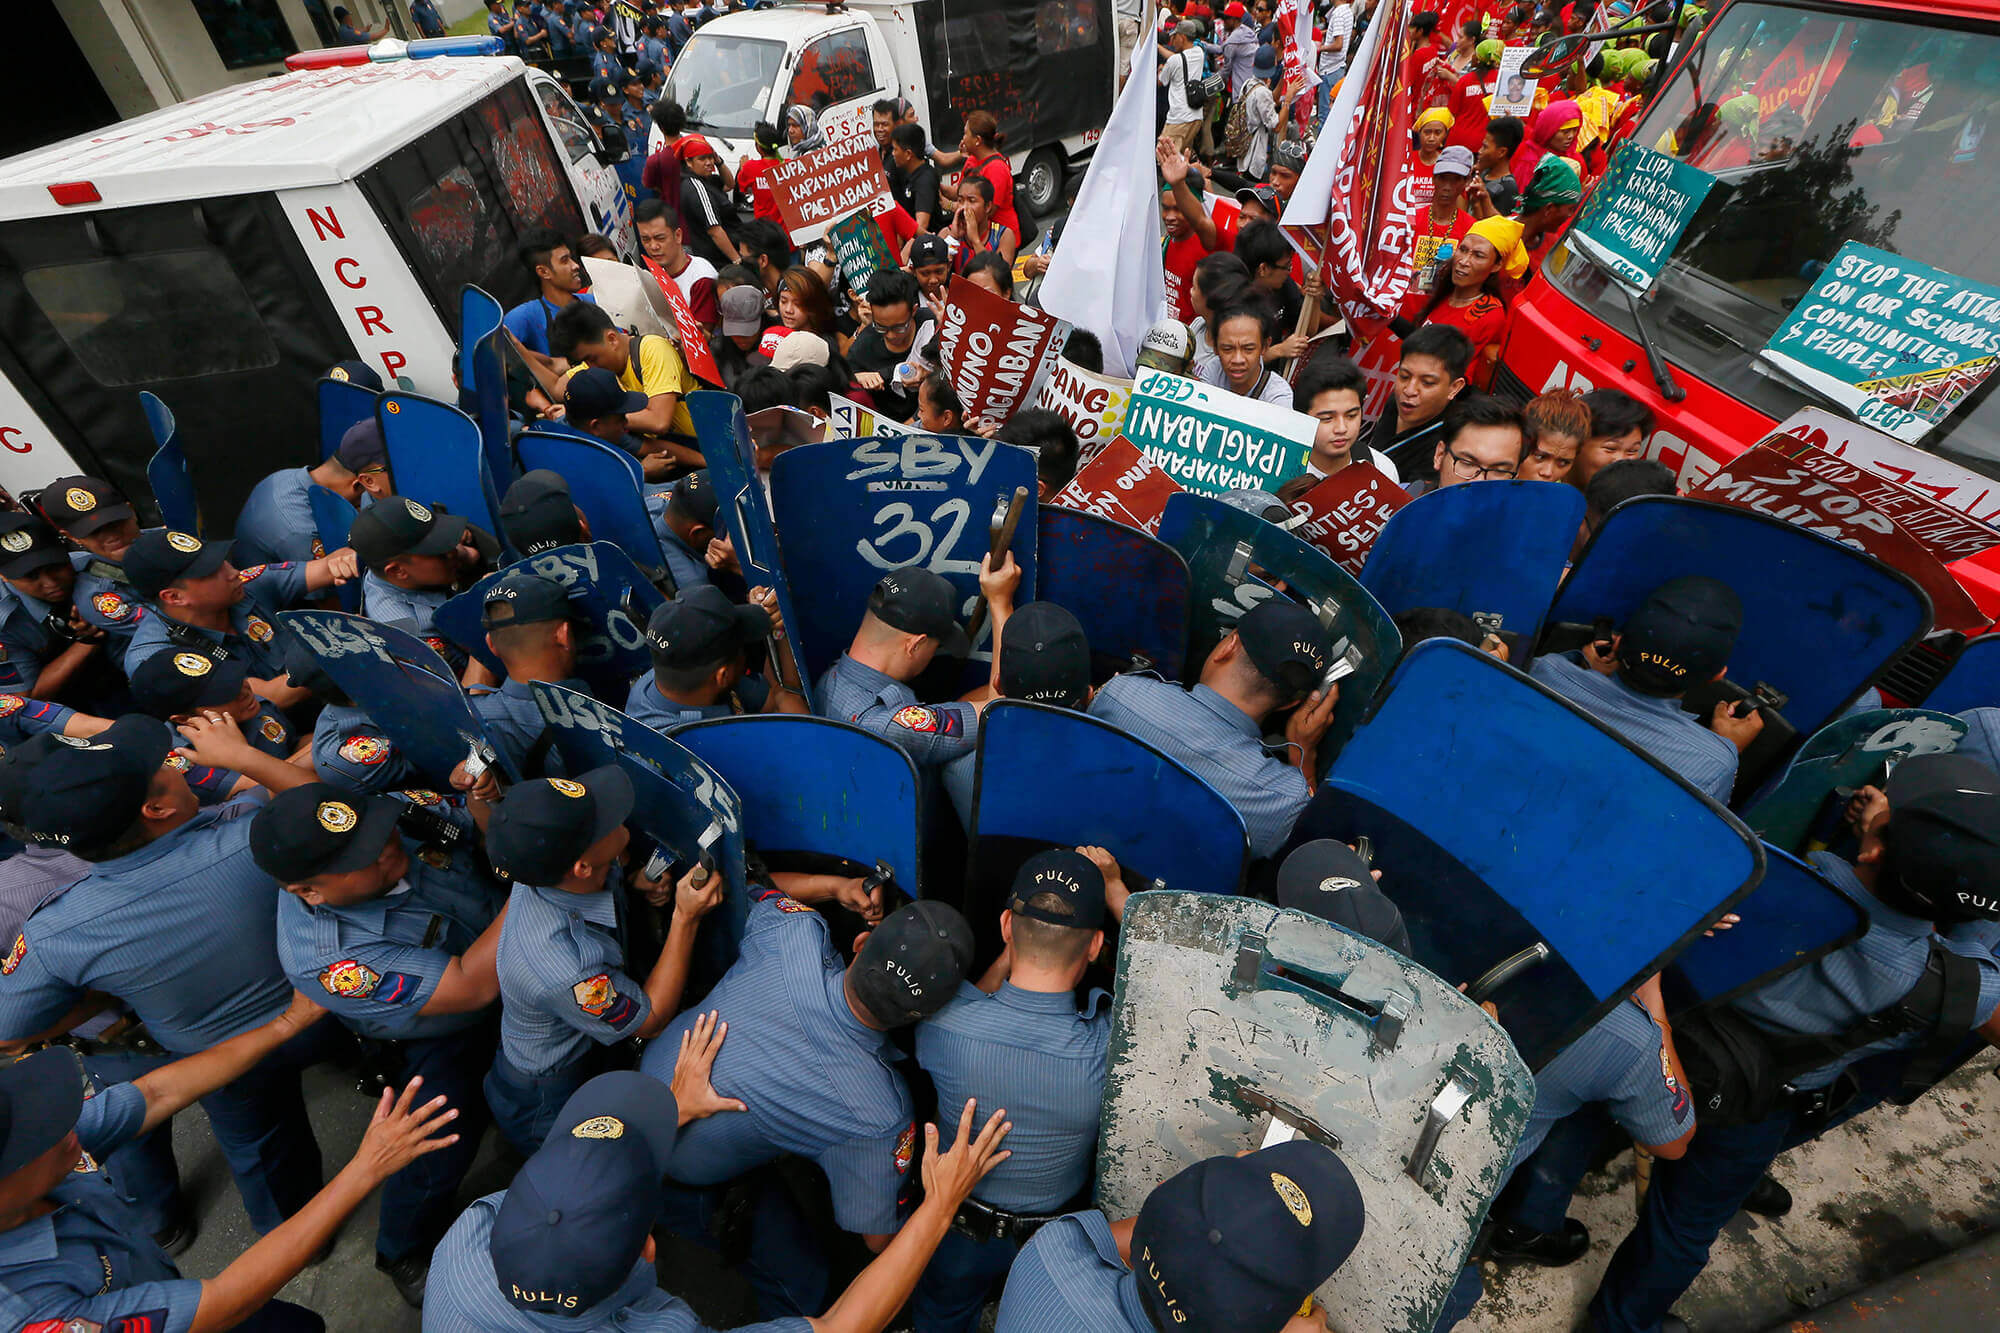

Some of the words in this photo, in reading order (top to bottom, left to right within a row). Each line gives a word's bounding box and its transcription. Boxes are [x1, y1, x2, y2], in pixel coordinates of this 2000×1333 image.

[813, 133, 879, 170] KARAPATAN
[1635, 149, 1675, 182] LUPA
[1612, 193, 1681, 241] KAPAYAPAAN
[1625, 172, 1691, 219] KARAPATAN
[1600, 211, 1667, 263] IPAGLABAN!
[1819, 281, 1857, 305] ON
[1855, 292, 1904, 320] OUR
[1835, 255, 1900, 288] STOP
[1898, 273, 1950, 305] THE
[1802, 304, 1959, 368] COMMUNITIES
[845, 433, 998, 486] SBY
[1128, 401, 1287, 478] IPAGLABAN!
[1116, 455, 1157, 490] OUR
[1750, 469, 1896, 535] STOP
[856, 497, 983, 575] 32
[1293, 640, 1324, 670] PULIS
[1640, 651, 1687, 677] PULIS
[1034, 868, 1081, 894] PULIS
[885, 958, 923, 998] PULIS
[511, 1283, 579, 1310] PULIS
[1141, 1244, 1189, 1326] PULIS
